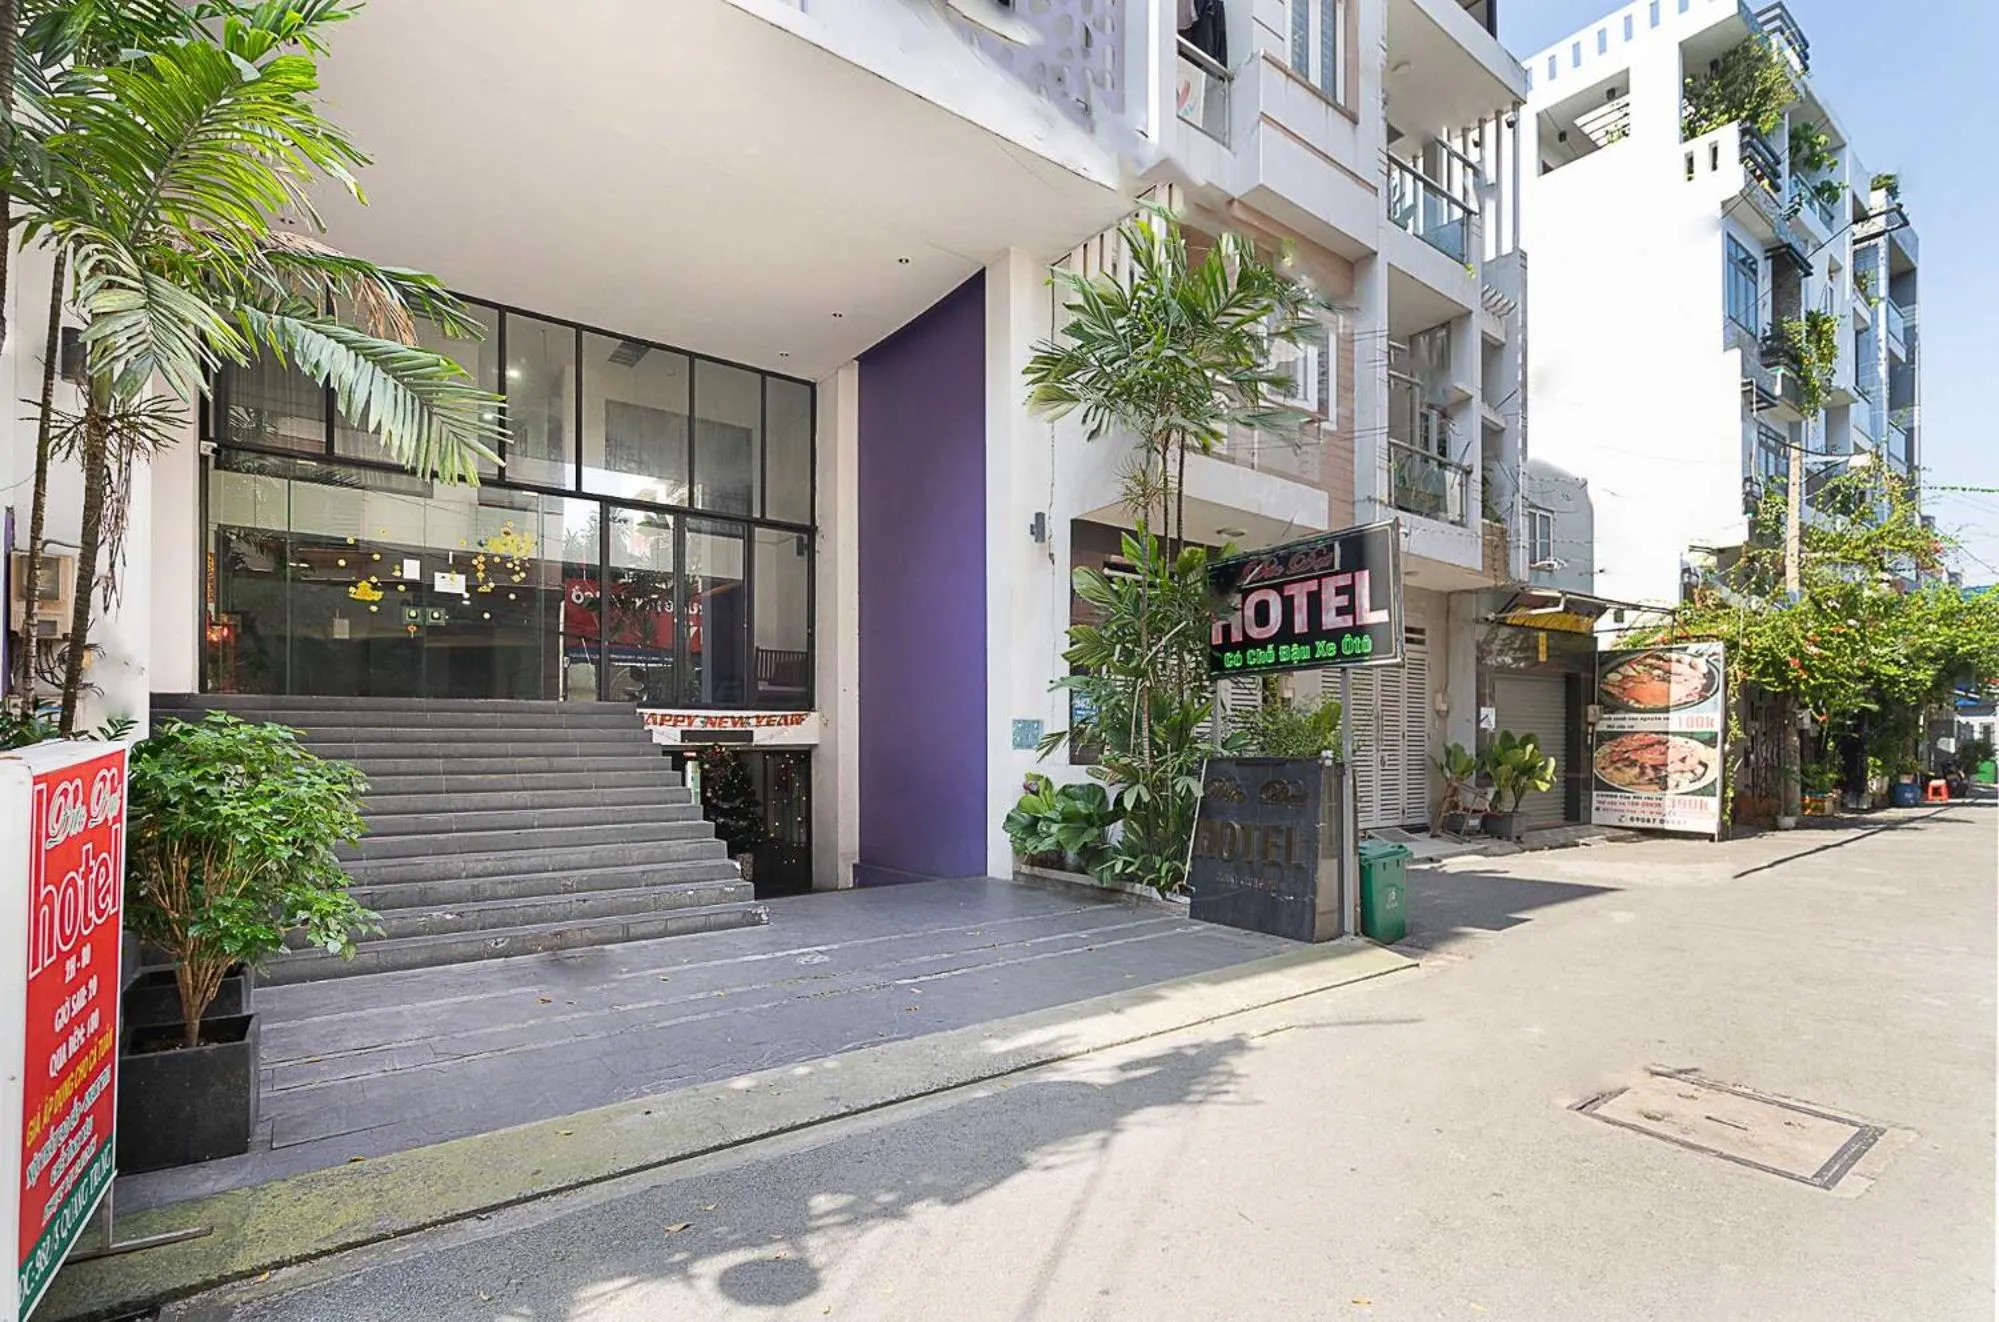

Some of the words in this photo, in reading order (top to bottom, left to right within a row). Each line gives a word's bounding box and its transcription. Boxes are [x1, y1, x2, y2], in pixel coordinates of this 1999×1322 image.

[1210, 569, 1389, 645] HOTEL
[1223, 650, 1242, 667] Có
[1315, 640, 1336, 658] Xe
[645, 712, 699, 727] APPY
[705, 715, 746, 728] NEW
[29, 783, 120, 980] hotel
